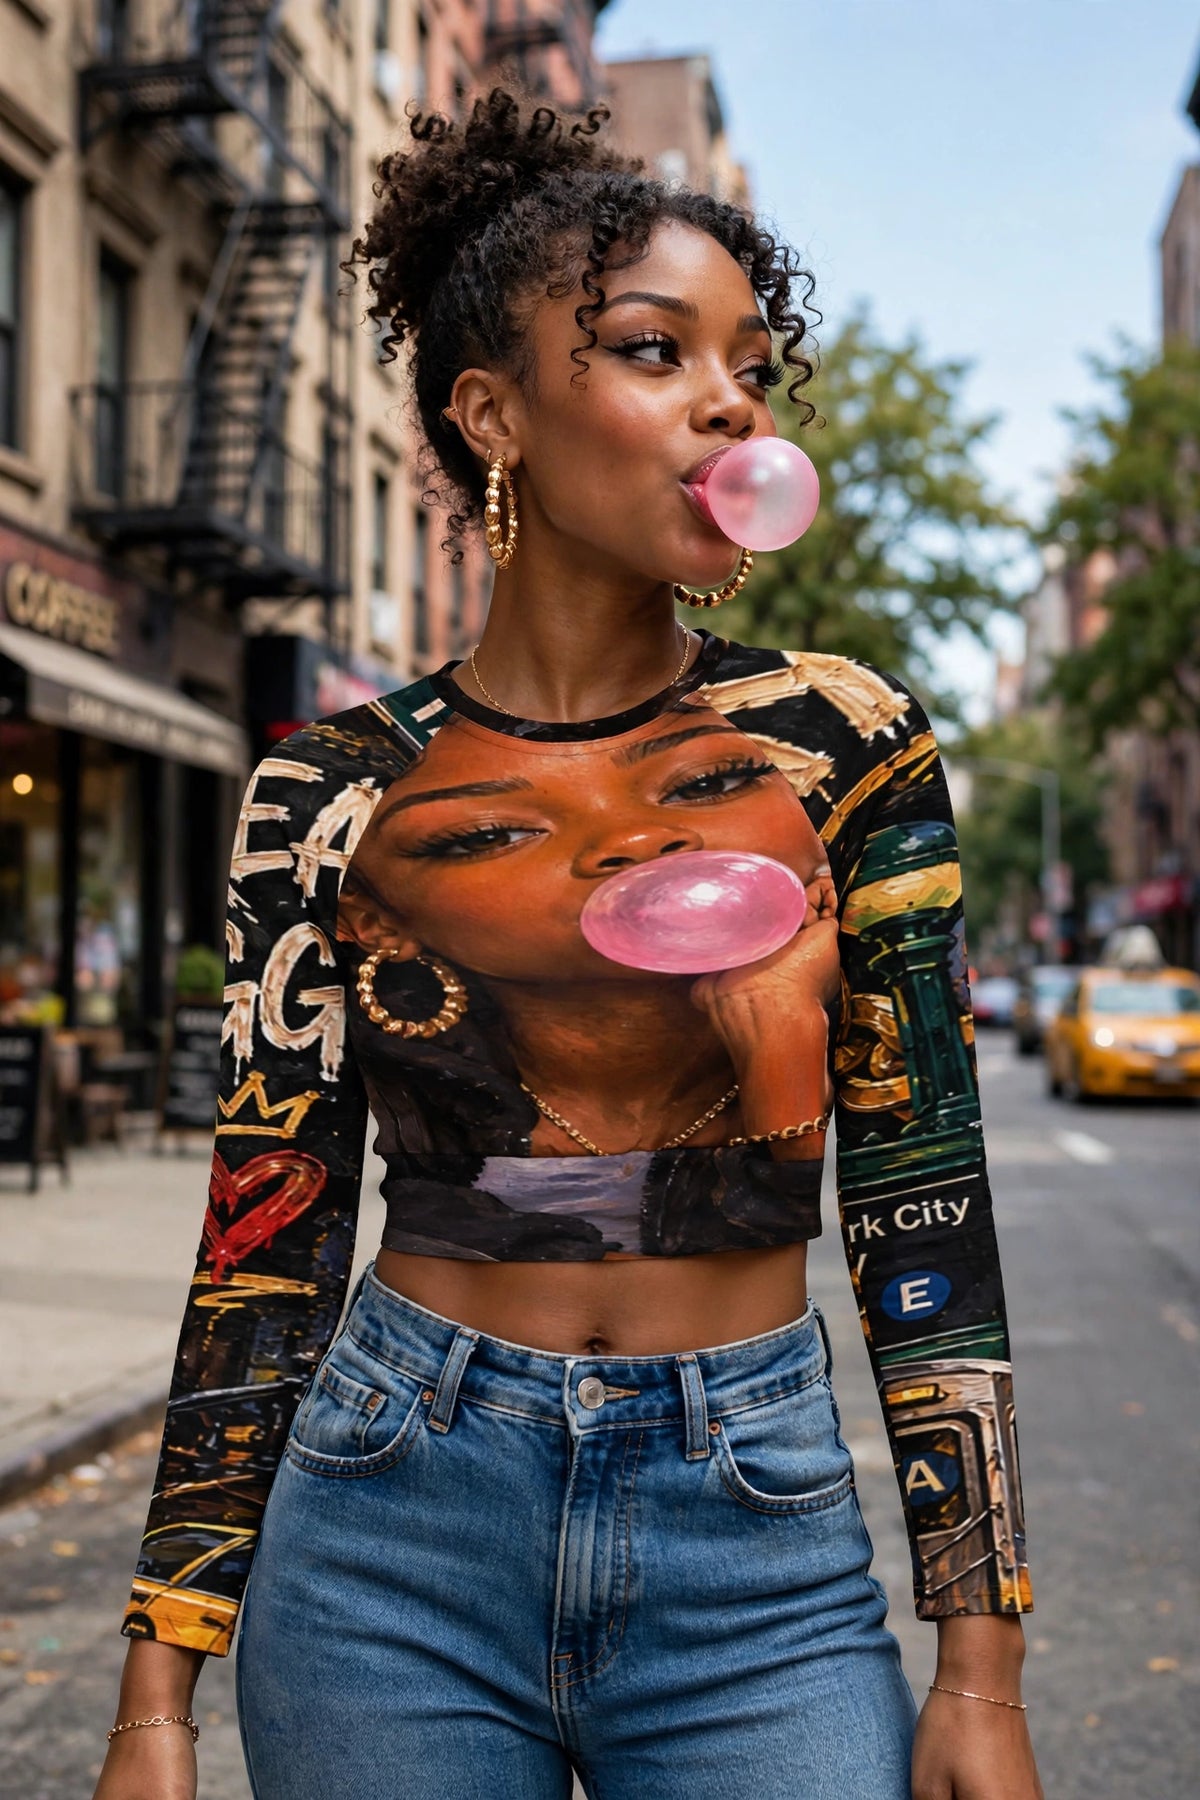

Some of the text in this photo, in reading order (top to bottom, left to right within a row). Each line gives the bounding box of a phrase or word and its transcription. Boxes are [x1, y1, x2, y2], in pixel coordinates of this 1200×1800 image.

[6, 561, 117, 655] COFFEE
[848, 1197, 970, 1243] rk City
[900, 1277, 934, 1313] E
[905, 1460, 946, 1496] A
